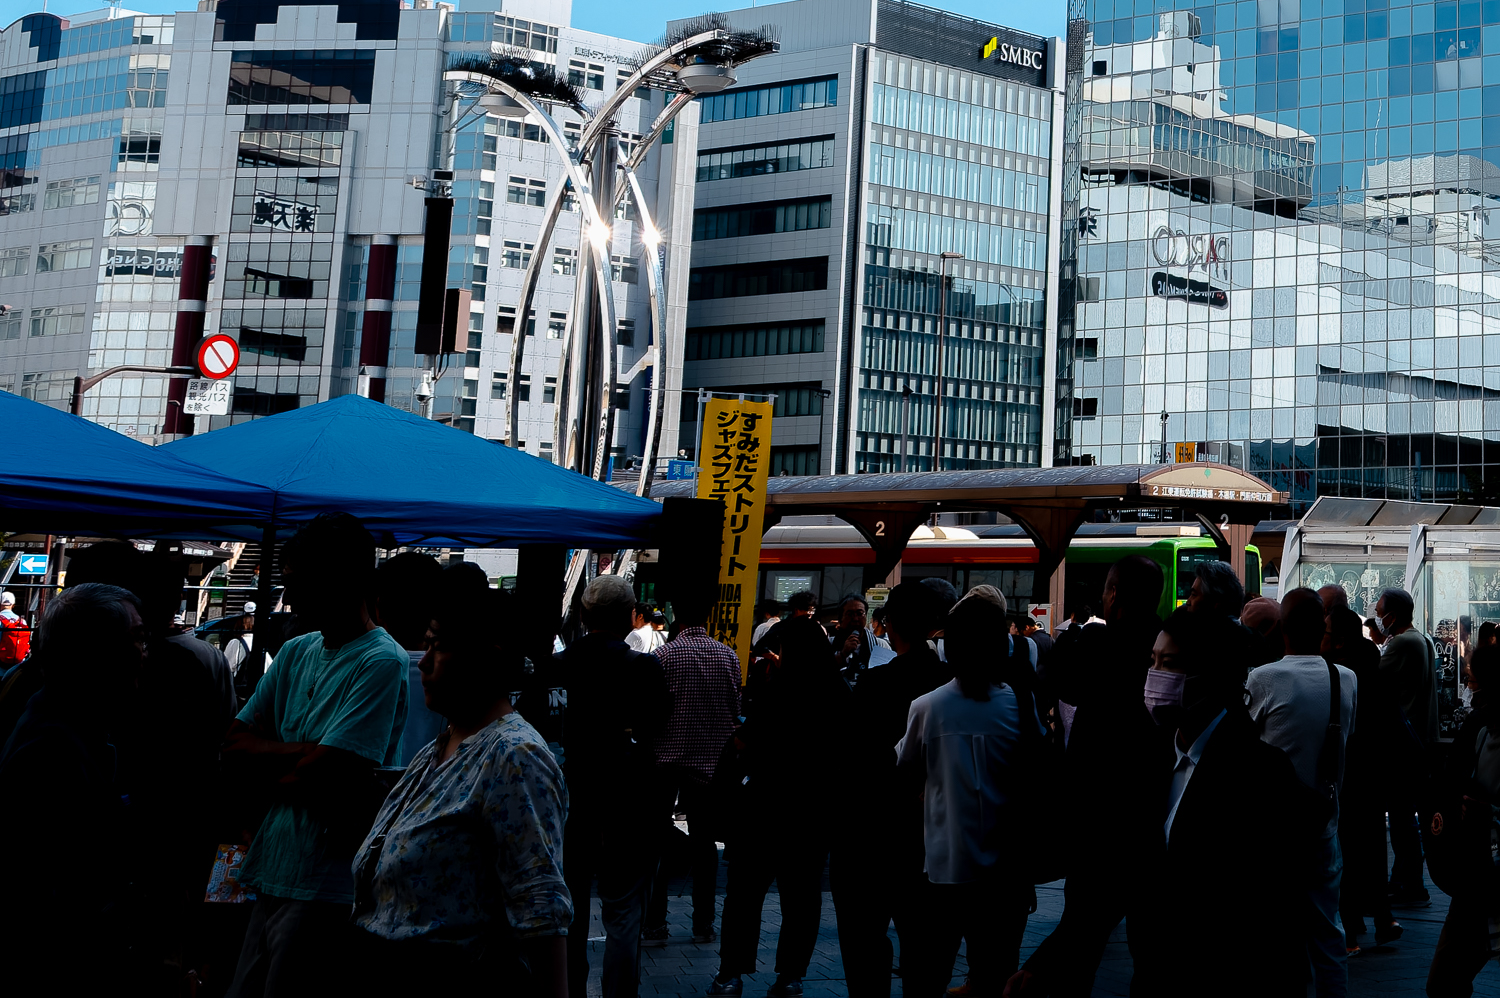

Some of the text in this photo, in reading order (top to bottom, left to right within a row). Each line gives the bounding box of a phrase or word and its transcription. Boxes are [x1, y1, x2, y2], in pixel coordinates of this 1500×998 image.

[1000, 42, 1043, 70] SMBC
[189, 381, 228, 392] 路線バス
[188, 392, 227, 402] 観光バス
[186, 402, 211, 412] を除く
[728, 412, 763, 577] すみだストリート
[1152, 485, 1159, 496] 2
[875, 520, 886, 537] 2
[1219, 513, 1230, 531] 2
